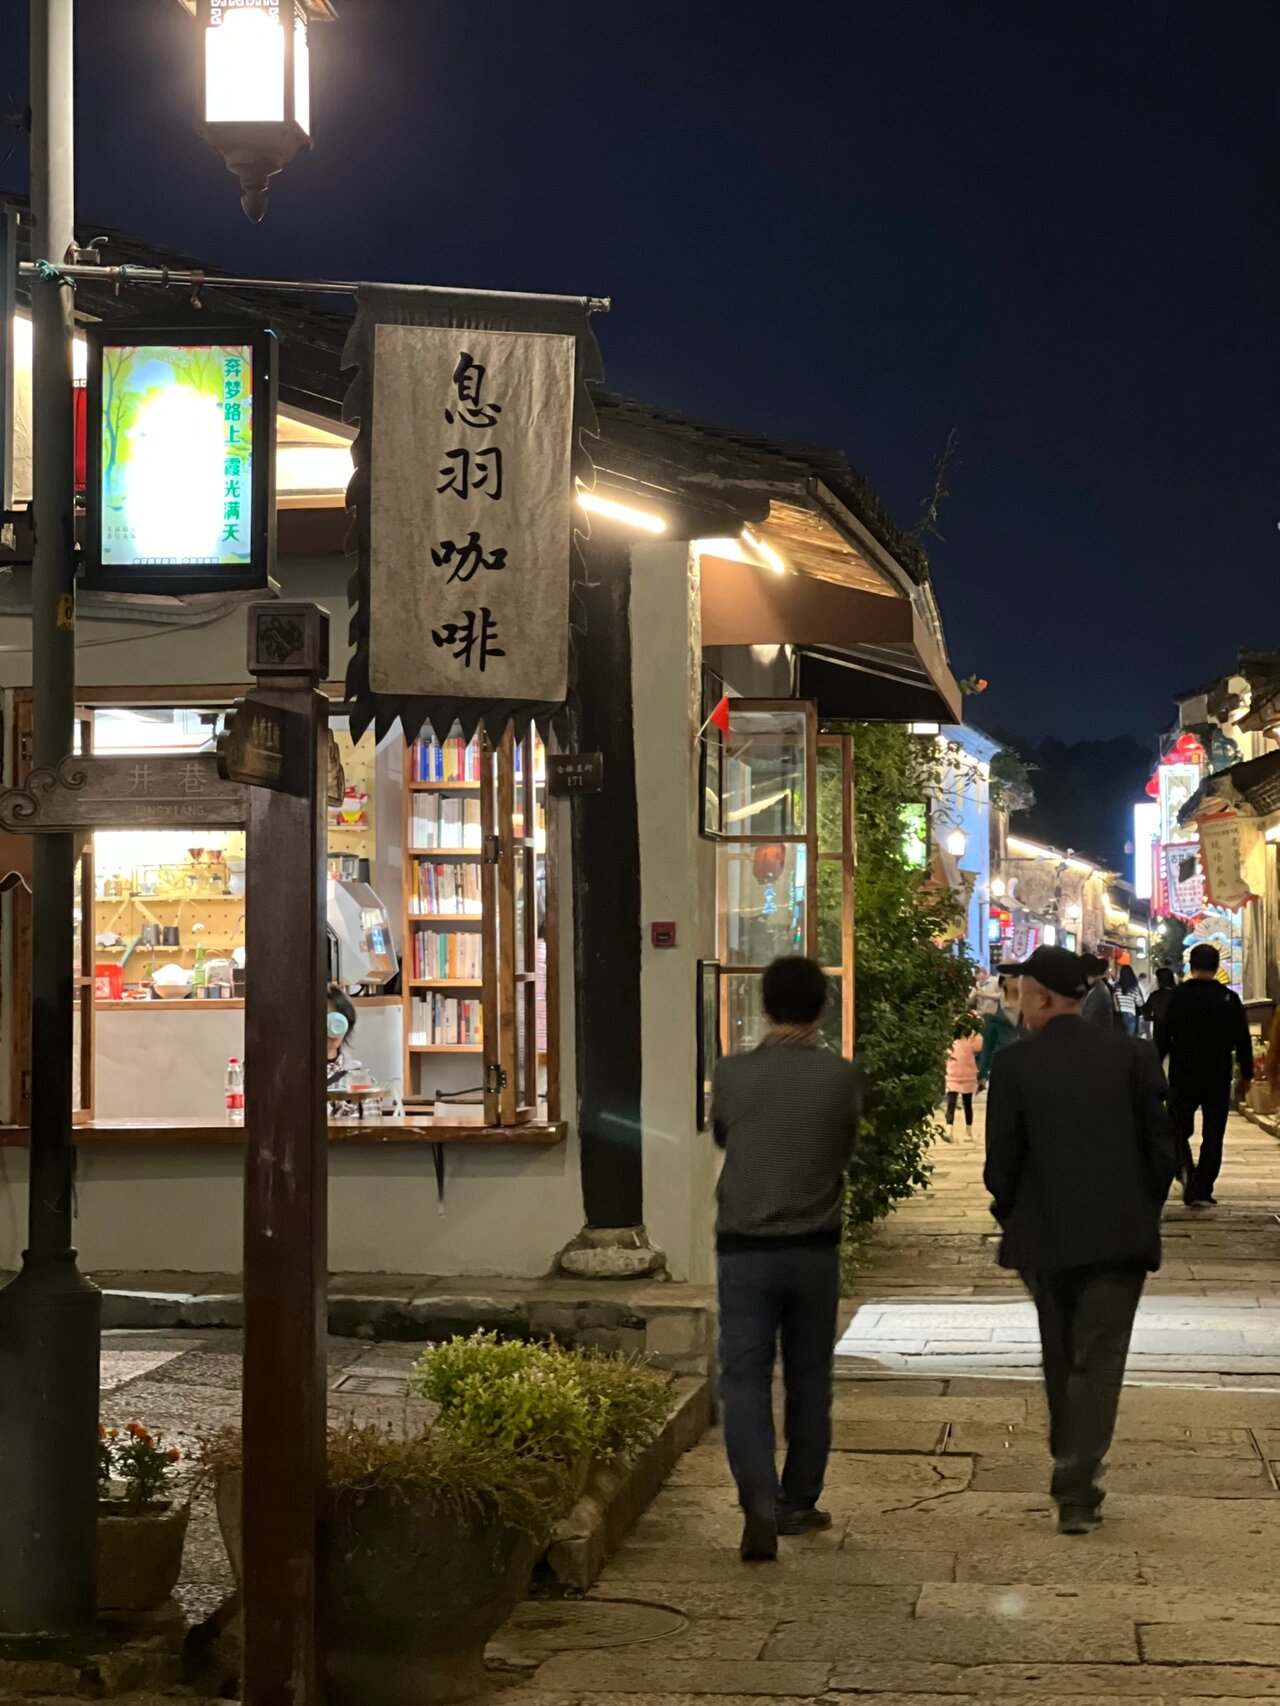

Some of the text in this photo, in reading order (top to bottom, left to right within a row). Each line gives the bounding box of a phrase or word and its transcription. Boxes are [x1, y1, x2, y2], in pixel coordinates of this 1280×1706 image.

[222, 358, 241, 542] 奔梦路上 霞光满天
[431, 351, 508, 672] 息羽咖啡
[127, 763, 207, 793] 井巷
[567, 775, 583, 786] 171
